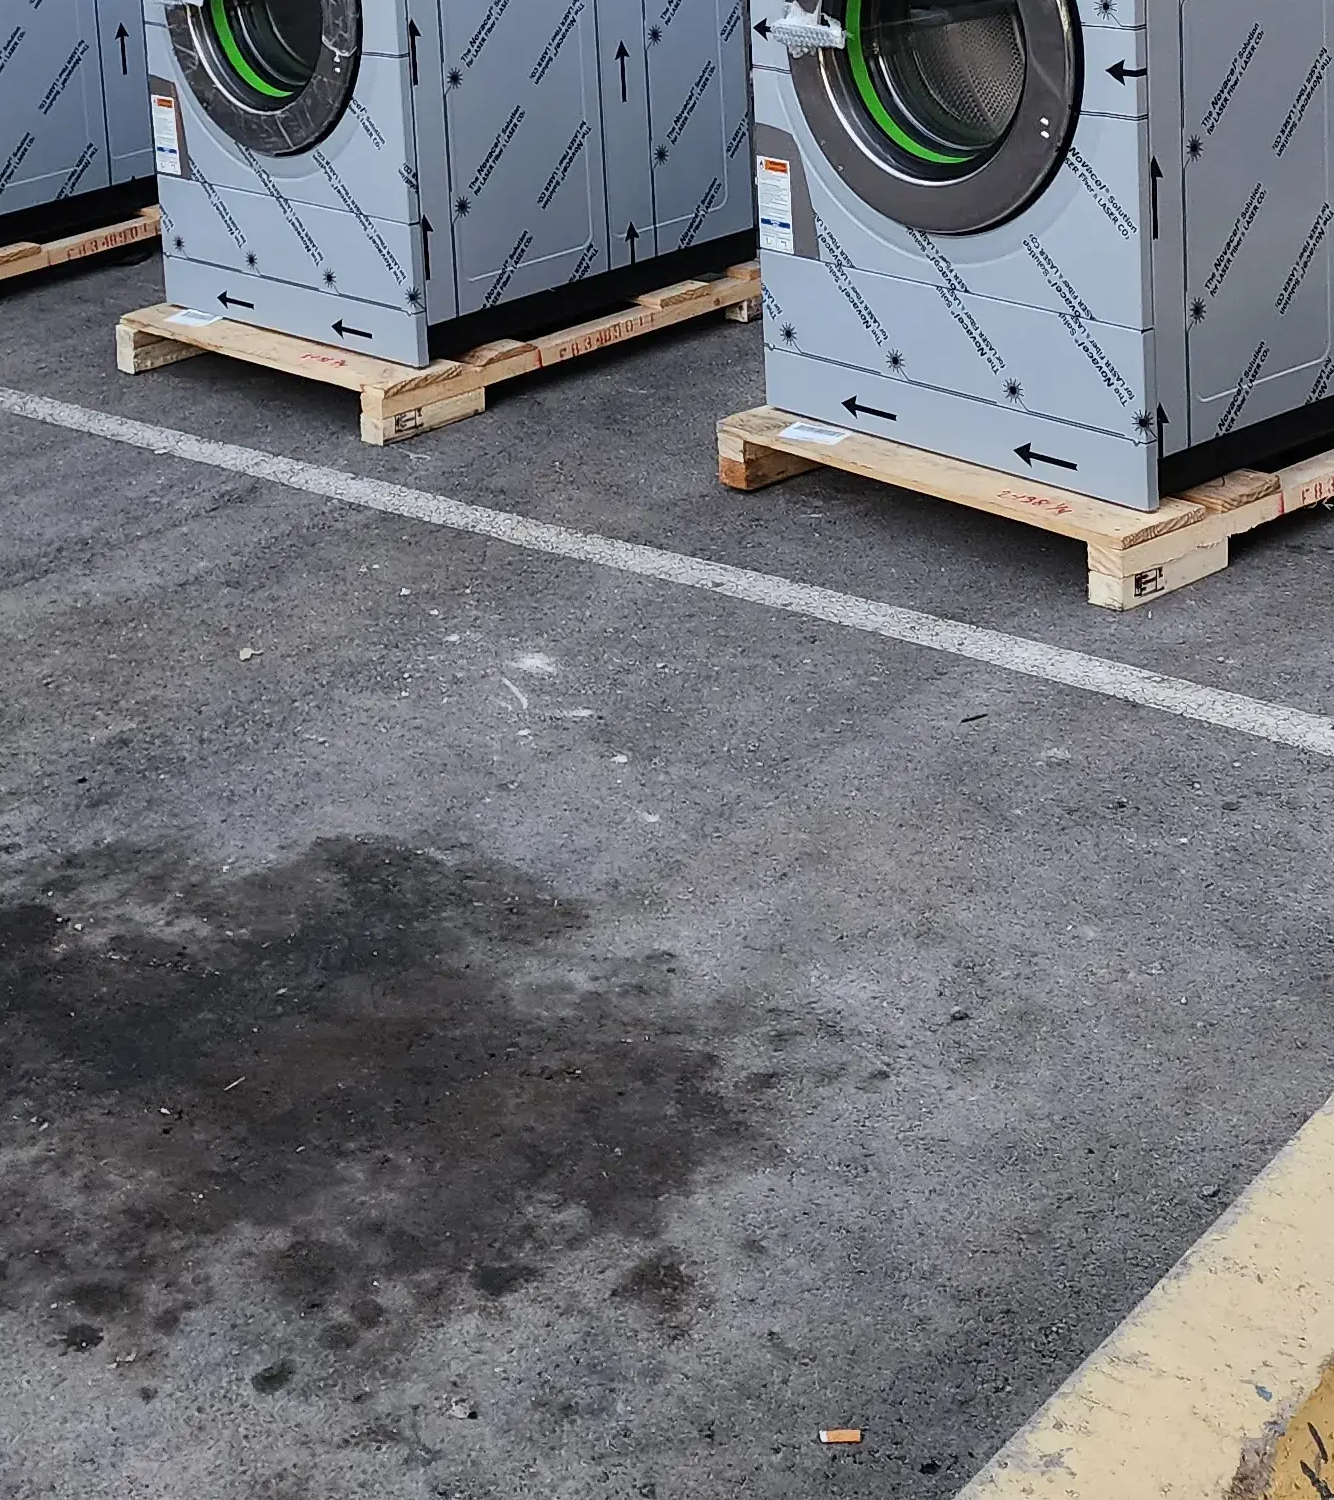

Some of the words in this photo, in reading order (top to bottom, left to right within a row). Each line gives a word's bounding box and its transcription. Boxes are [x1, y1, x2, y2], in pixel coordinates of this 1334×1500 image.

[1096, 198, 1119, 224] LASER
[1106, 195, 1140, 233] Solution
[1038, 247, 1061, 275] LASER
[849, 285, 866, 305] Fiber
[1061, 278, 1079, 300] Fiber
[862, 304, 882, 329] LASER
[963, 310, 980, 331] Fiber
[869, 328, 885, 347] The
[878, 327, 890, 341] for
[977, 331, 998, 357] LASER
[1088, 338, 1107, 360] Fiber
[984, 356, 1000, 375] The
[994, 355, 1007, 369] for
[1103, 359, 1127, 387] LASER
[1112, 387, 1129, 407] The
[1123, 386, 1136, 401] for
